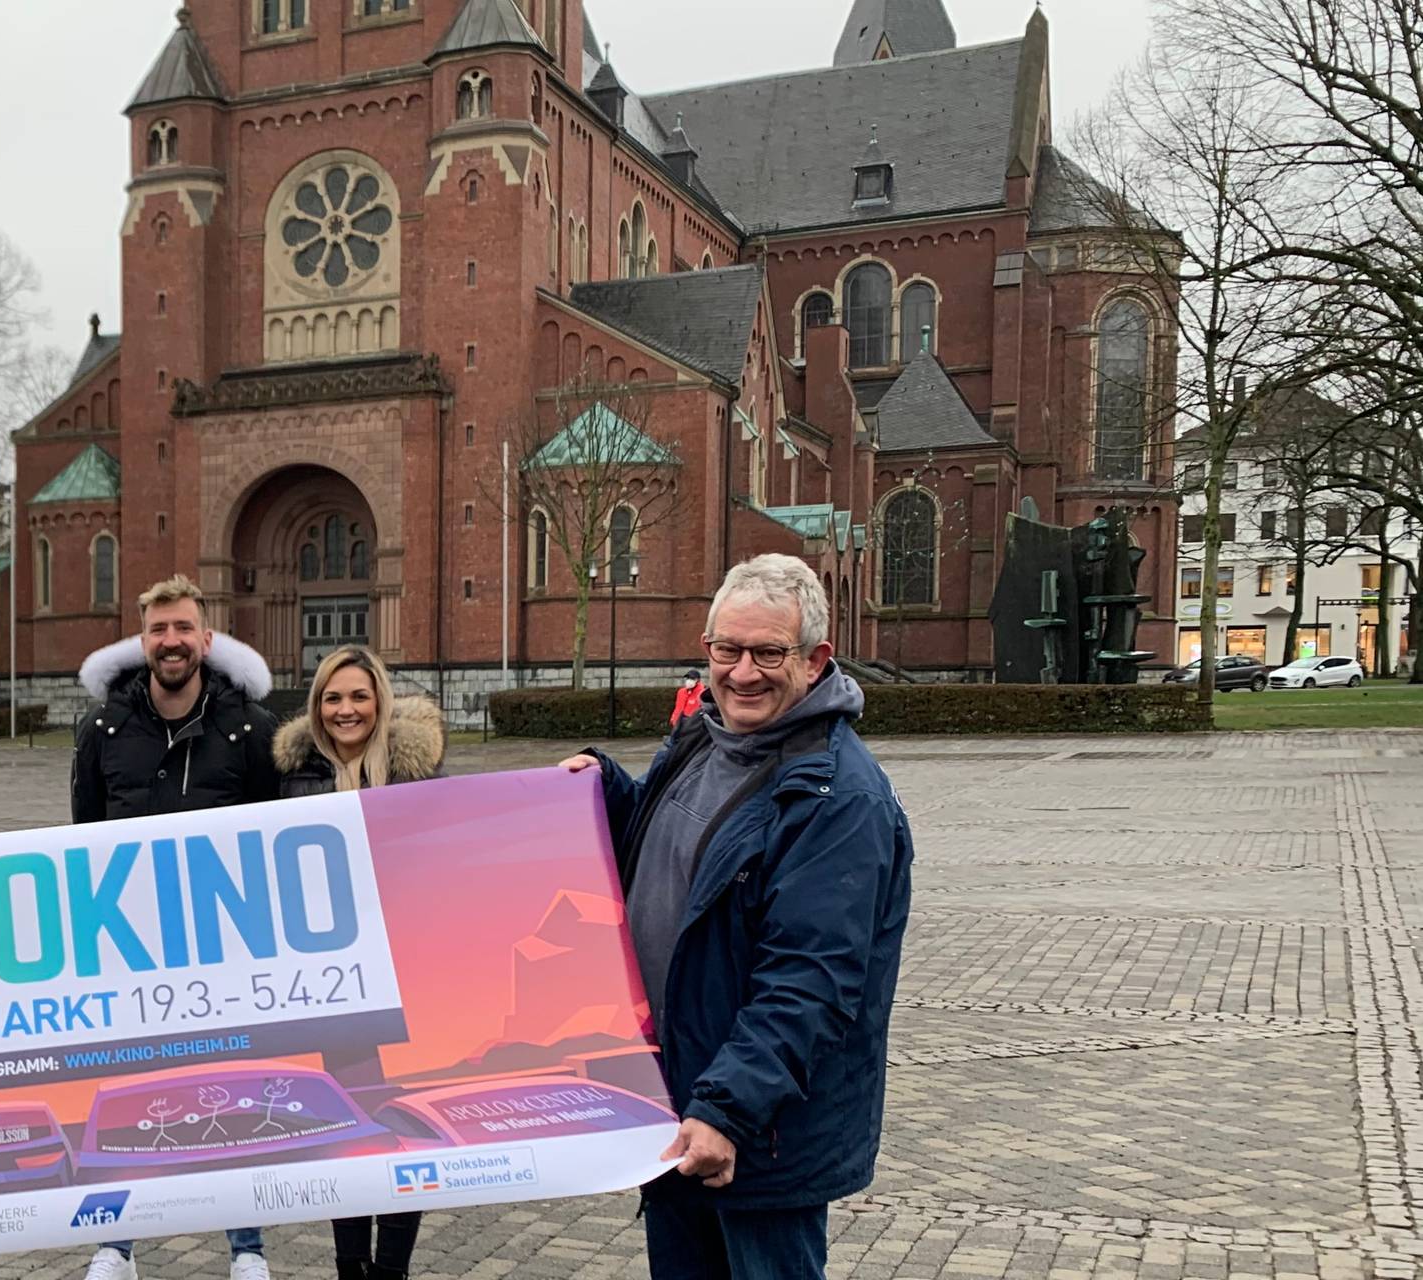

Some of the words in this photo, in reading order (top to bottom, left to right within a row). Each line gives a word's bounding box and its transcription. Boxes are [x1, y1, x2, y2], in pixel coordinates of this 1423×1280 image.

[65, 1034, 251, 1069] WWW.KINO-NEHEIM.DE
[443, 1100, 515, 1121] APOLLO
[523, 1087, 613, 1111] CENTRAL
[481, 1120, 509, 1132] Die
[504, 1115, 548, 1130] Kinos
[542, 1112, 562, 1124] in
[559, 1106, 615, 1122] Neheim
[441, 1154, 511, 1172] Volksbank
[444, 1170, 511, 1188] Sauerland
[514, 1168, 534, 1182] eG
[77, 1206, 116, 1227] wfa
